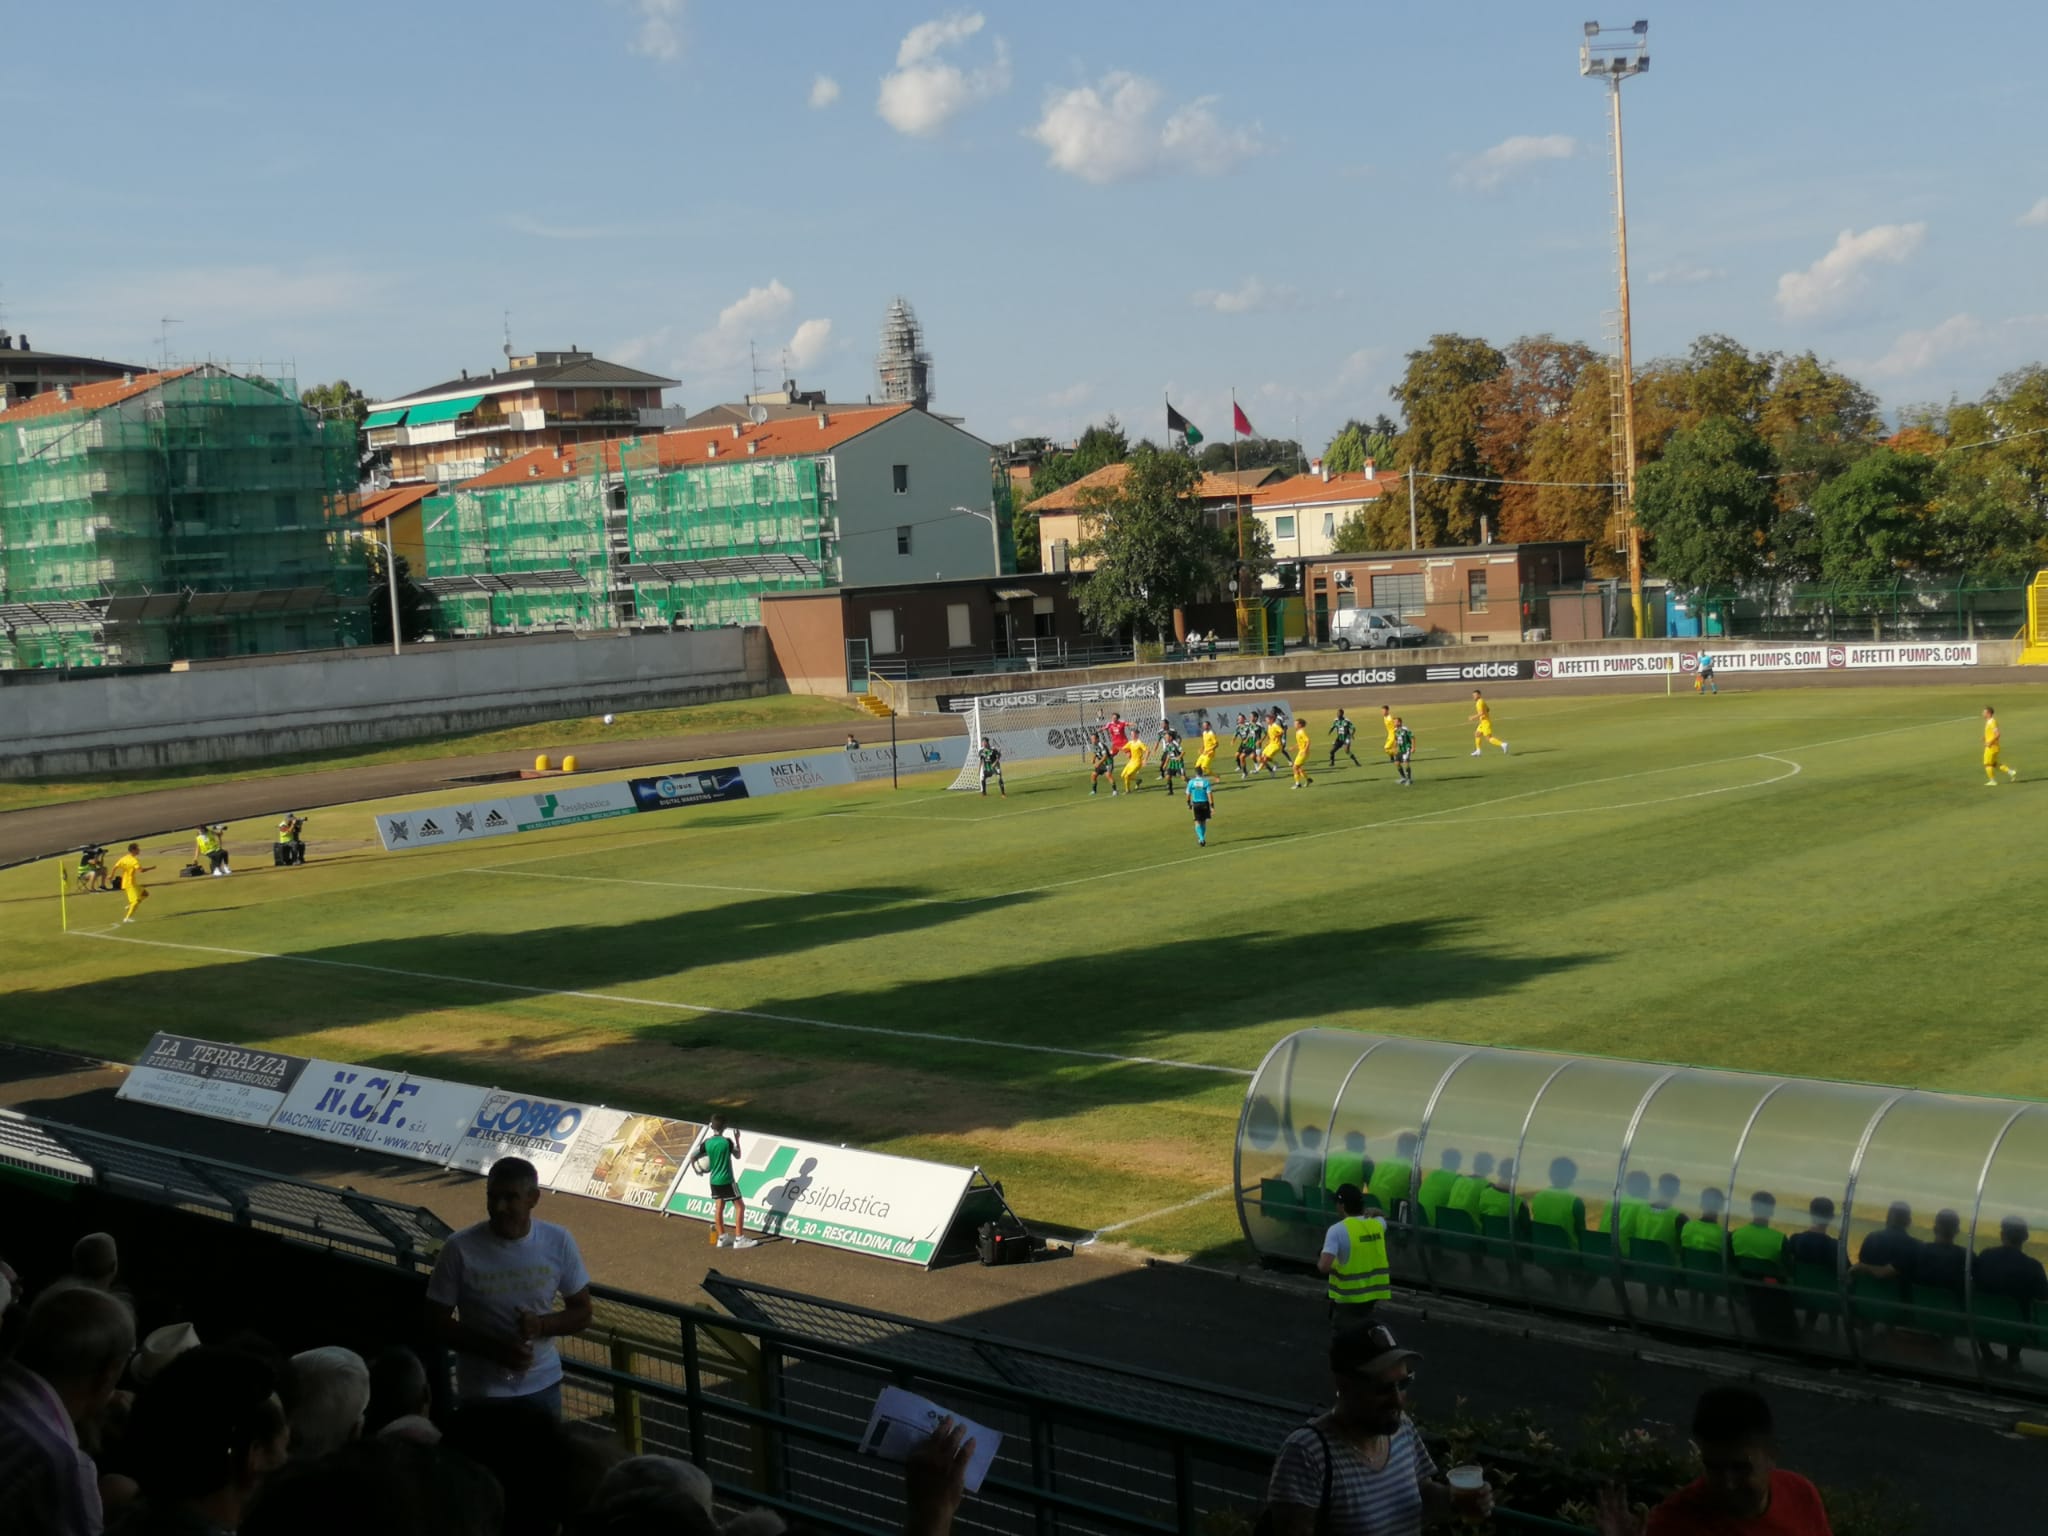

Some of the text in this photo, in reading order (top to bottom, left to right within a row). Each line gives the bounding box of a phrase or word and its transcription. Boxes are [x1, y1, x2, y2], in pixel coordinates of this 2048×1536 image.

[1711, 654, 1746, 668] FFETTI
[1750, 651, 1821, 667] PUMPS.COM
[1852, 649, 1895, 663] AFFETTI
[1899, 647, 1972, 662] PUMPS.COM
[1462, 662, 1518, 679] adidas
[1558, 659, 1599, 674] AFFETTI
[1220, 675, 1275, 692] adidas
[1340, 668, 1396, 685] adidas
[1101, 684, 1155, 700] adidas
[770, 763, 804, 777] META
[774, 772, 824, 788] ENERGIA
[154, 1039, 289, 1077] LA TERRAZZA
[146, 1056, 197, 1073] PIZZERIA
[212, 1068, 281, 1088] STEAKHOUSE
[277, 1111, 328, 1133] MACCHINE
[329, 1121, 379, 1144] UTENSILI
[780, 1178, 892, 1219] Tessilplastica
[685, 1198, 703, 1213] VIA
[702, 1202, 736, 1219] DELA
[801, 1222, 817, 1236] 30
[821, 1226, 892, 1252] RESCALDINA
